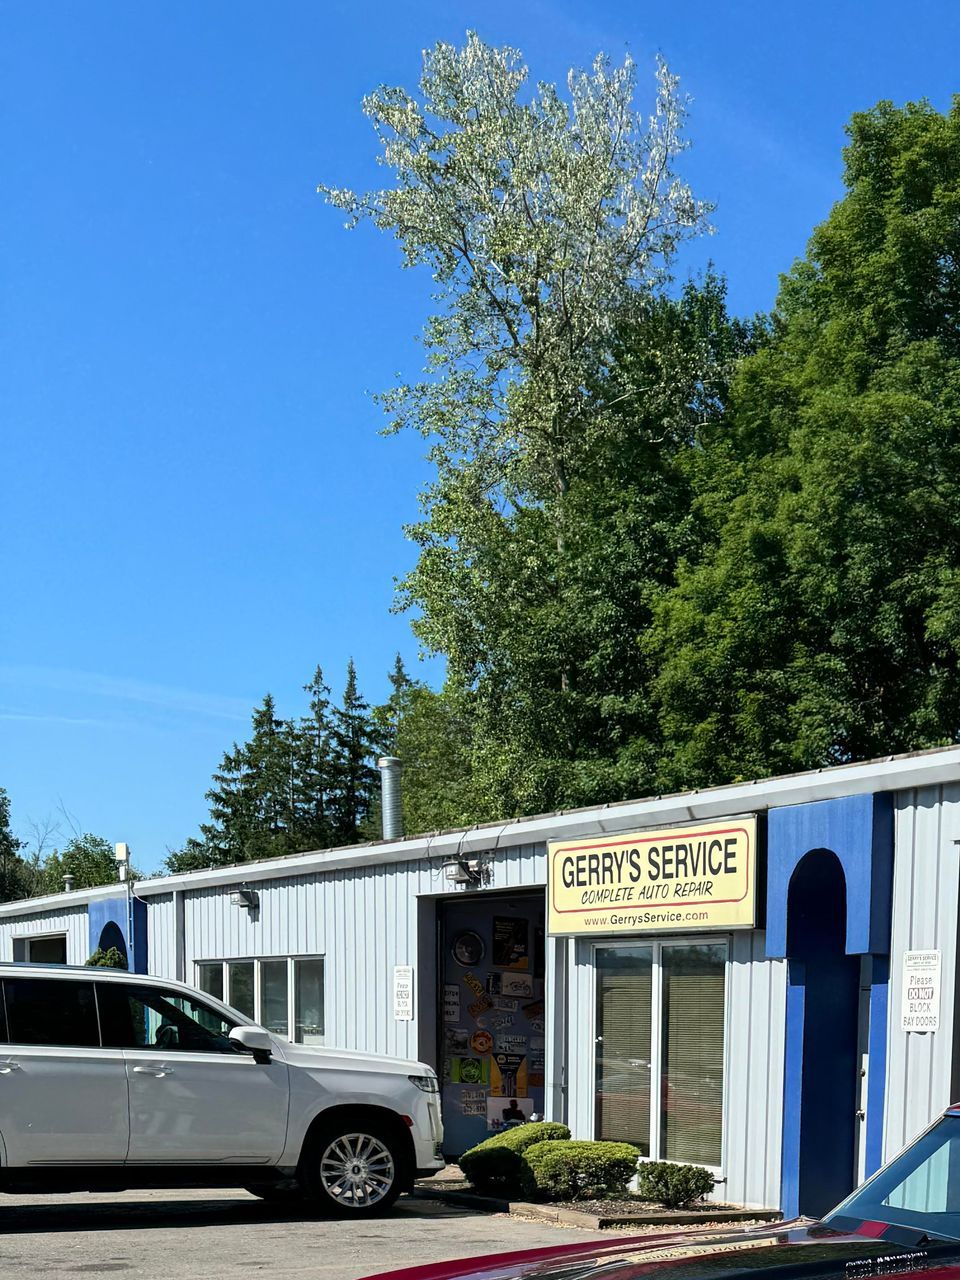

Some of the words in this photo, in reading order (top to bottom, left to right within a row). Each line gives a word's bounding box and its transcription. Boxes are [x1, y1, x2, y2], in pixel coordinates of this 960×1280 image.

[562, 849, 642, 888] GERRY'S
[647, 838, 738, 881] SERVICE
[581, 886, 635, 905] COMPLETE
[638, 883, 669, 900] AUTO
[673, 880, 713, 898] REPAIR
[584, 911, 708, 928] www.GerrysService.com
[909, 975, 933, 985] Please
[908, 988, 919, 1000] DO
[919, 988, 933, 1000] NOT
[909, 1002, 931, 1013] BLOCK
[903, 1016, 914, 1026] BAY
[915, 1016, 937, 1026] DOORS
